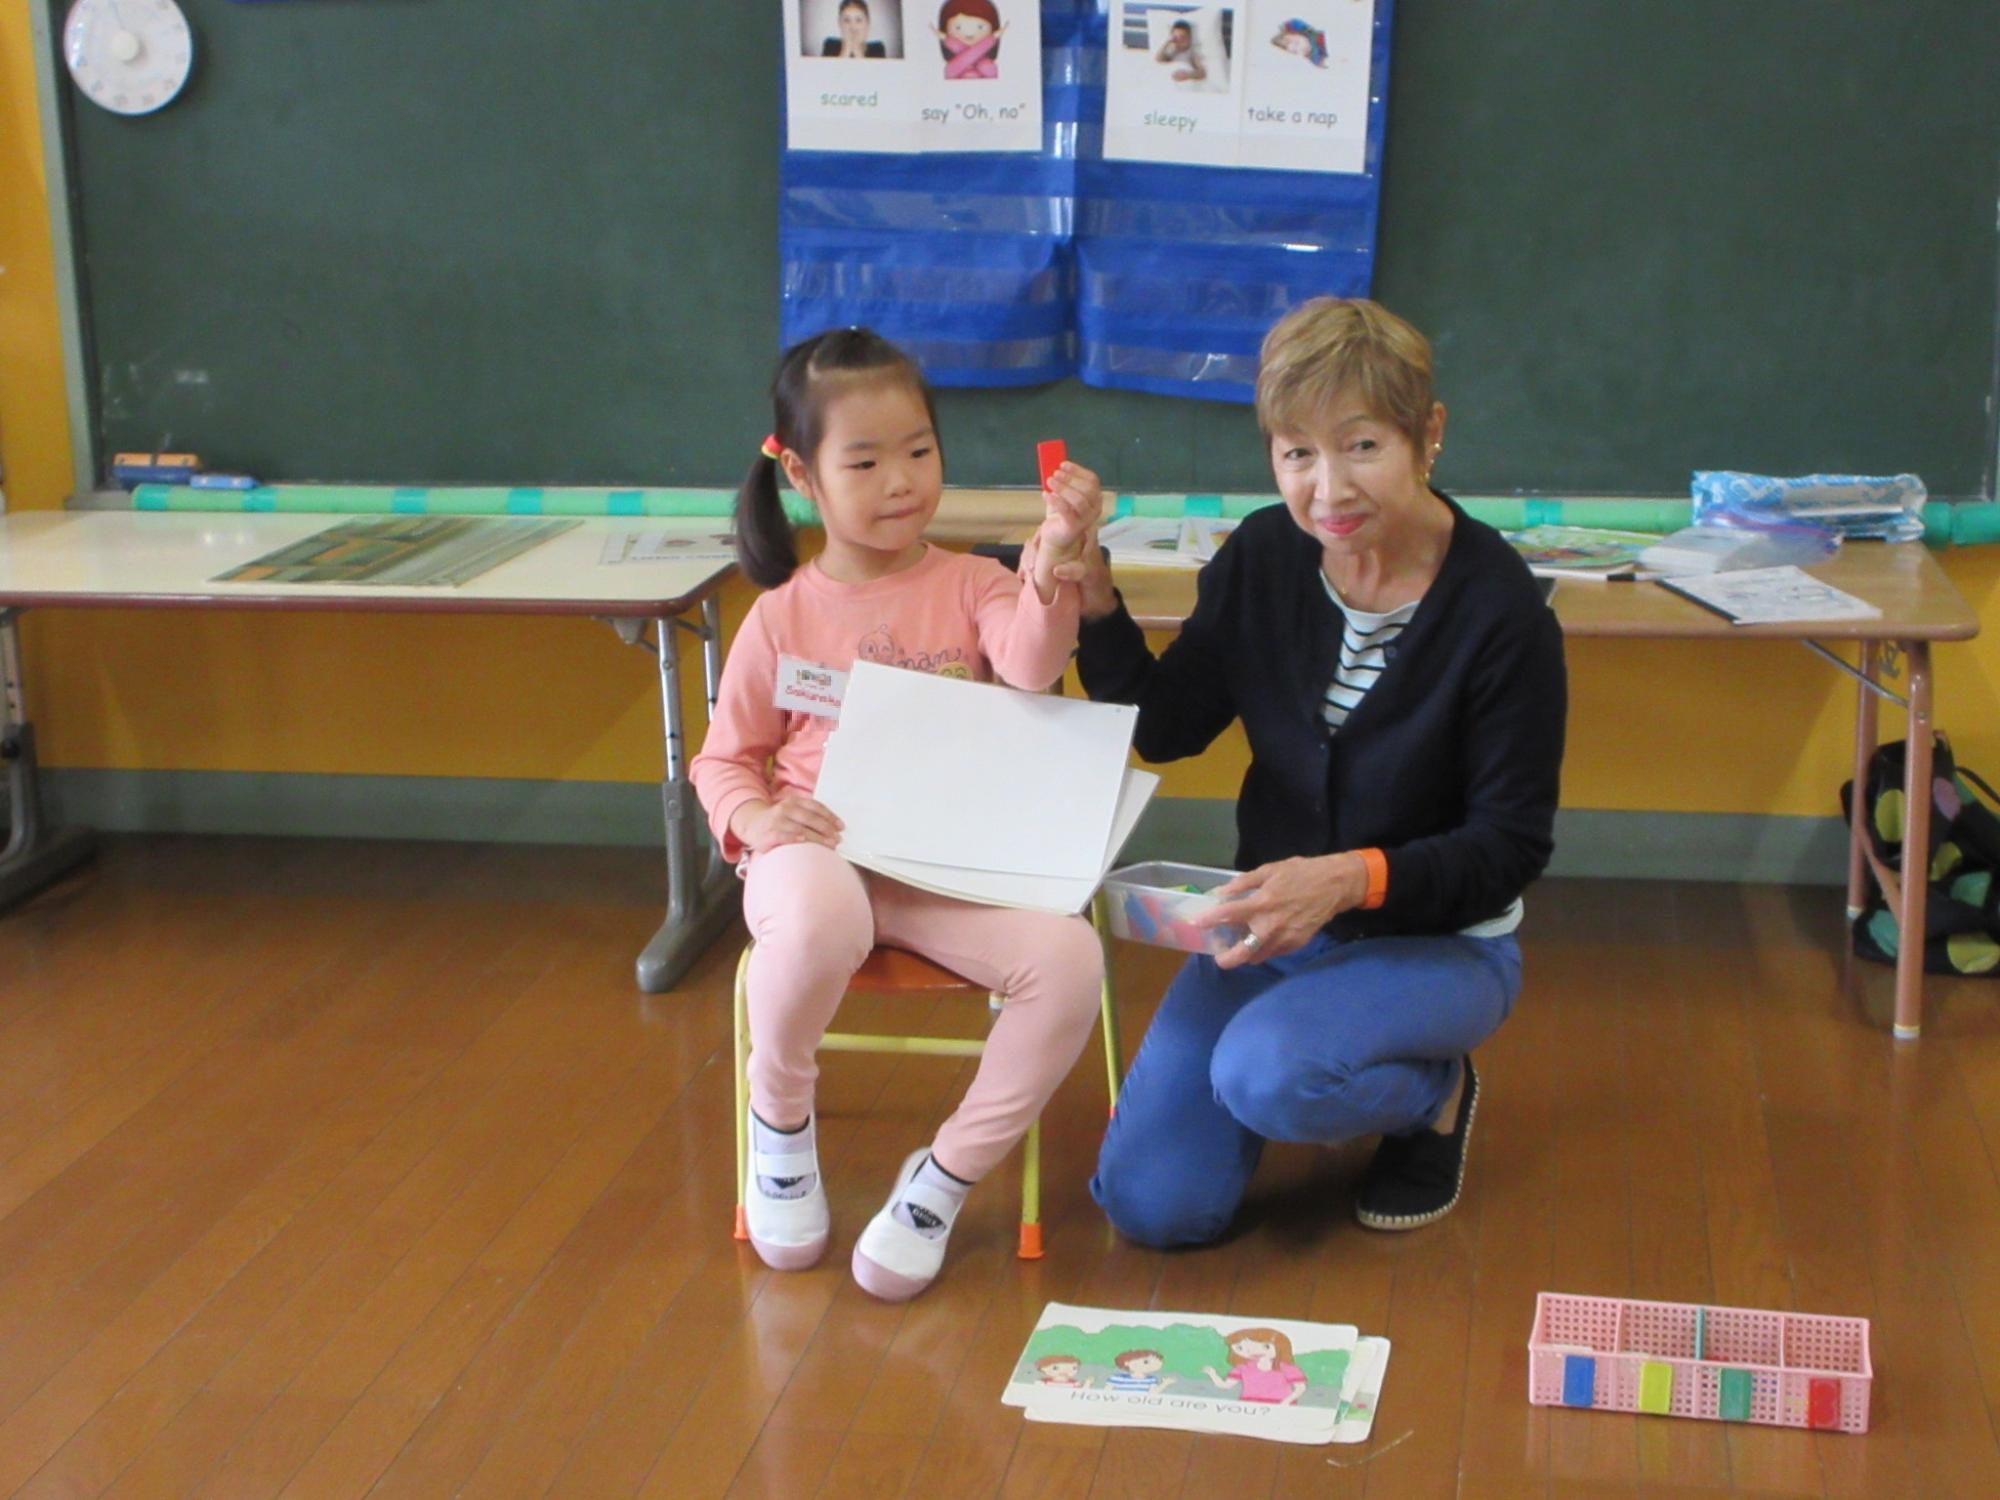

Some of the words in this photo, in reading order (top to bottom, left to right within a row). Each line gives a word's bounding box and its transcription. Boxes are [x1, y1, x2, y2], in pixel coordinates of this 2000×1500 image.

[820, 91, 878, 107] scared
[921, 107, 949, 124] say
[1143, 109, 1198, 132] sleepy
[1247, 106, 1285, 122] take
[1292, 110, 1302, 123] a
[1307, 111, 1338, 128] nap
[1070, 1389, 1121, 1404] How
[1127, 1391, 1163, 1406] old
[1170, 1397, 1208, 1411] are
[1215, 1401, 1271, 1417] you?
